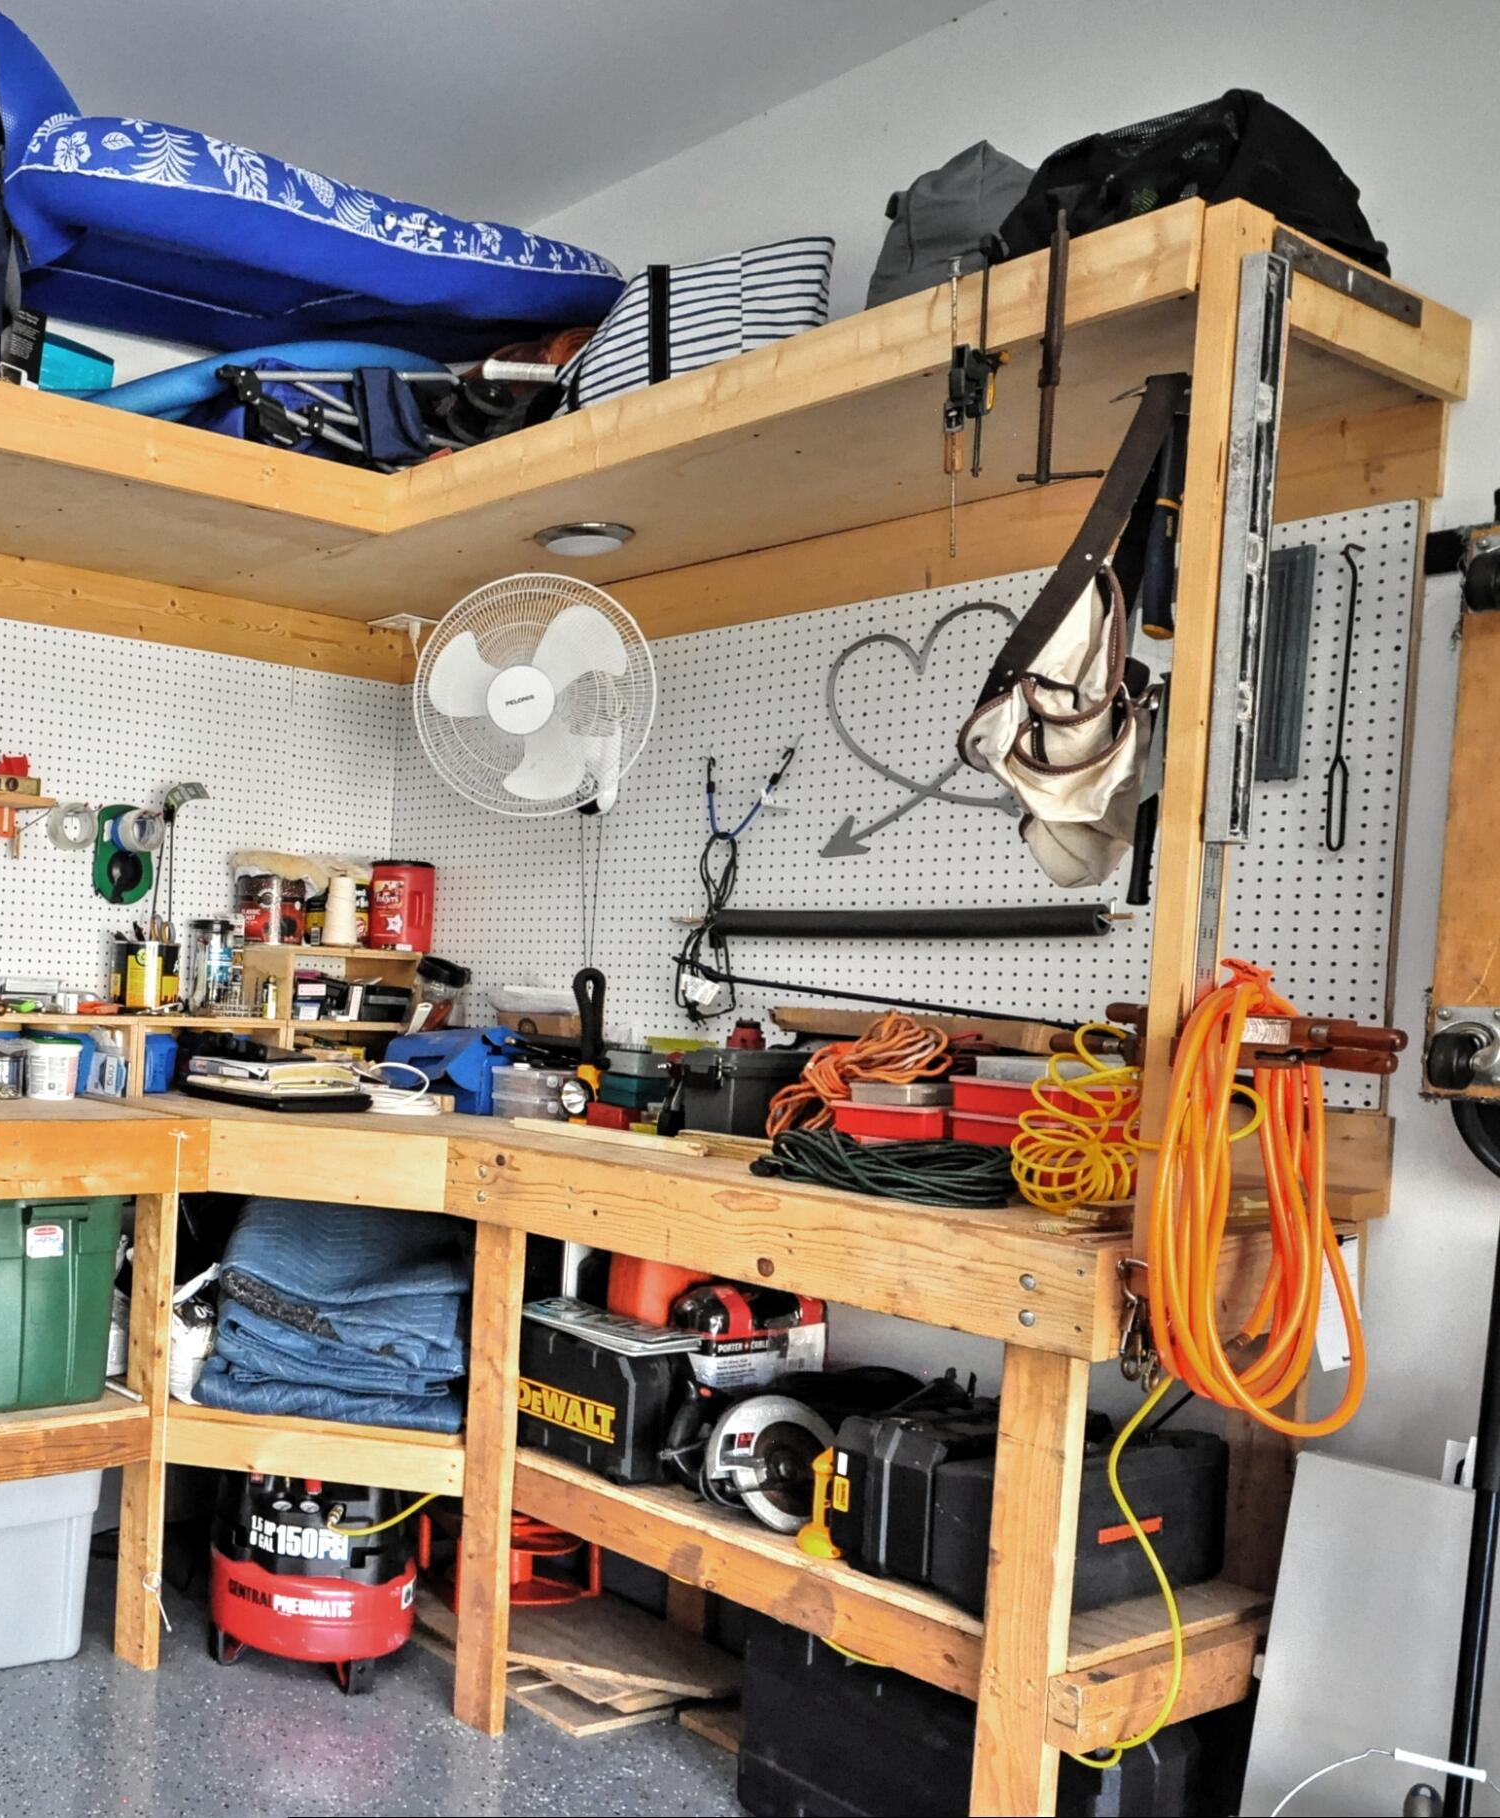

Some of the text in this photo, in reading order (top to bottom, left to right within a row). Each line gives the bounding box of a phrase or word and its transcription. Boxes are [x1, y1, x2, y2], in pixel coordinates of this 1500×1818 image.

[717, 1342, 743, 1353] PORTER
[228, 1578, 352, 1618] CENTRAL PNEUMATIC
